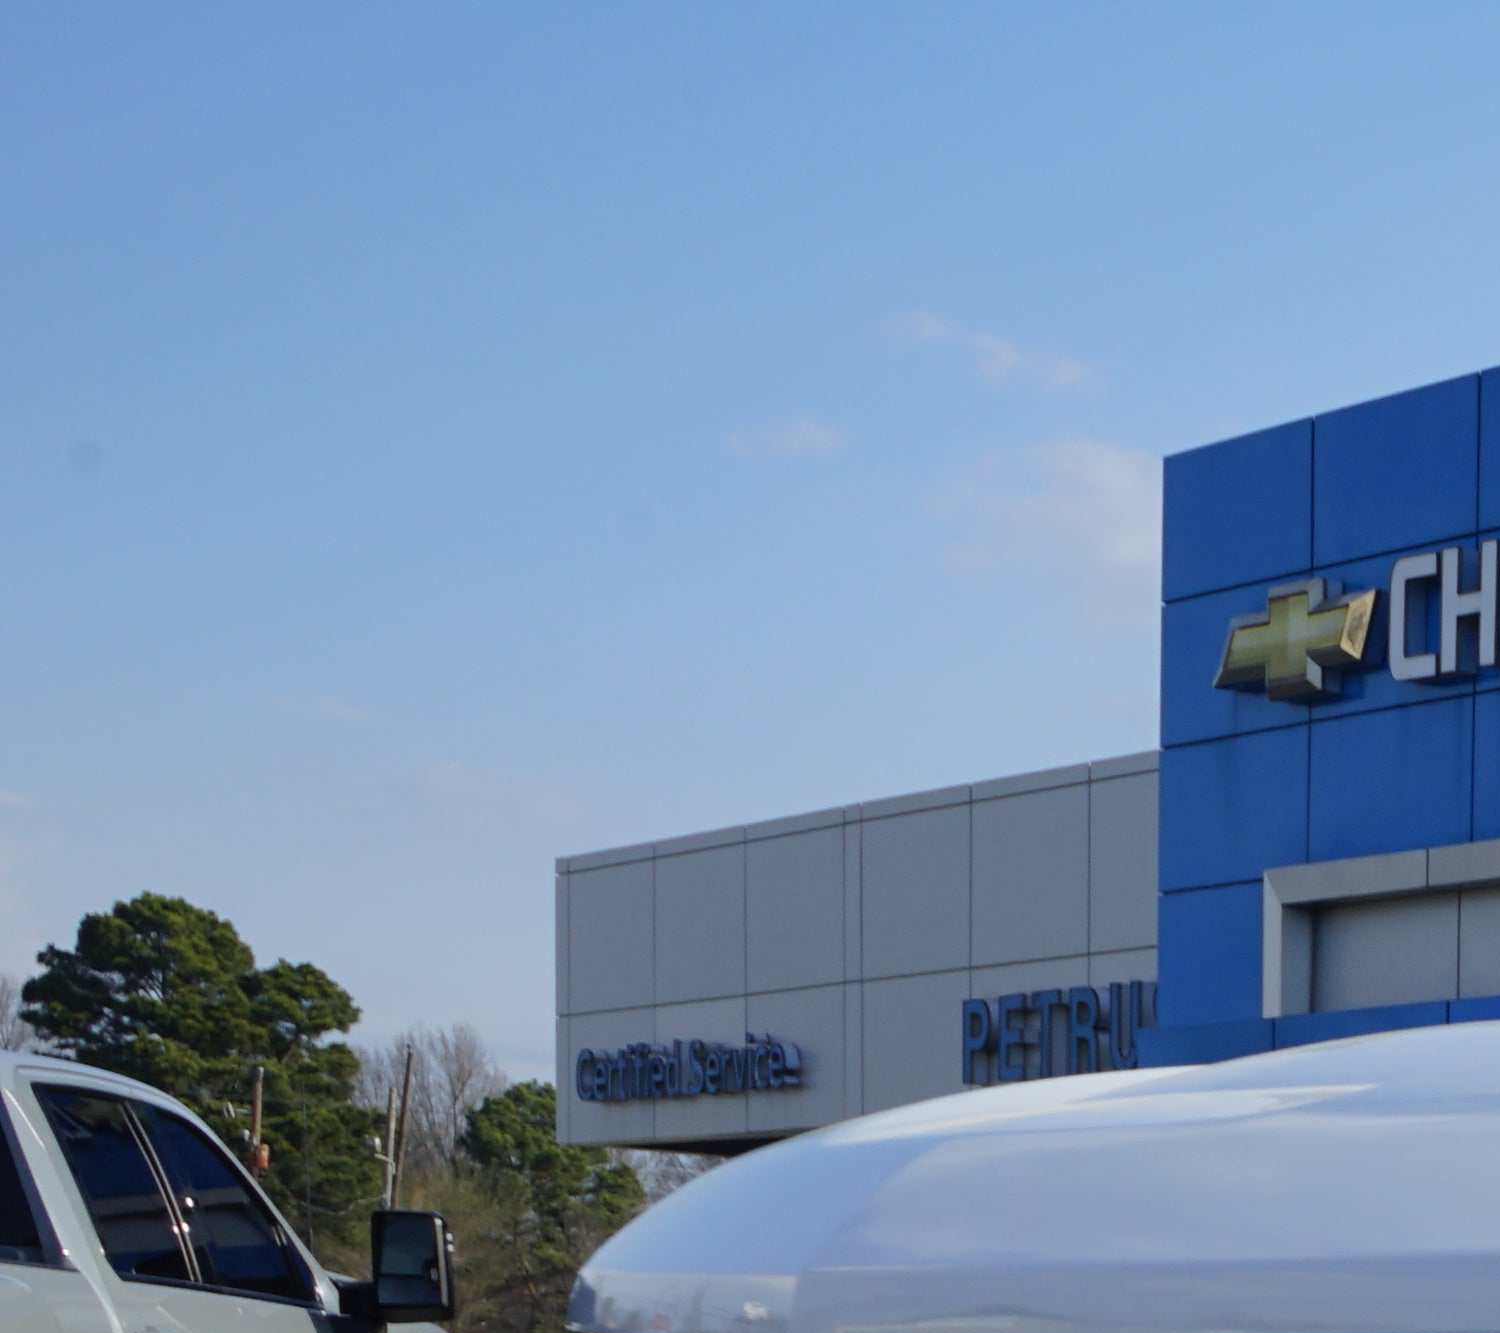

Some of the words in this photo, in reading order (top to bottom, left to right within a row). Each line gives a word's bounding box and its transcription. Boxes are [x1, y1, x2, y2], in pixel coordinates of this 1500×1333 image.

[576, 1038, 684, 1101] Certified
[688, 1031, 787, 1094] Service
[962, 979, 1158, 1085] PETRU
